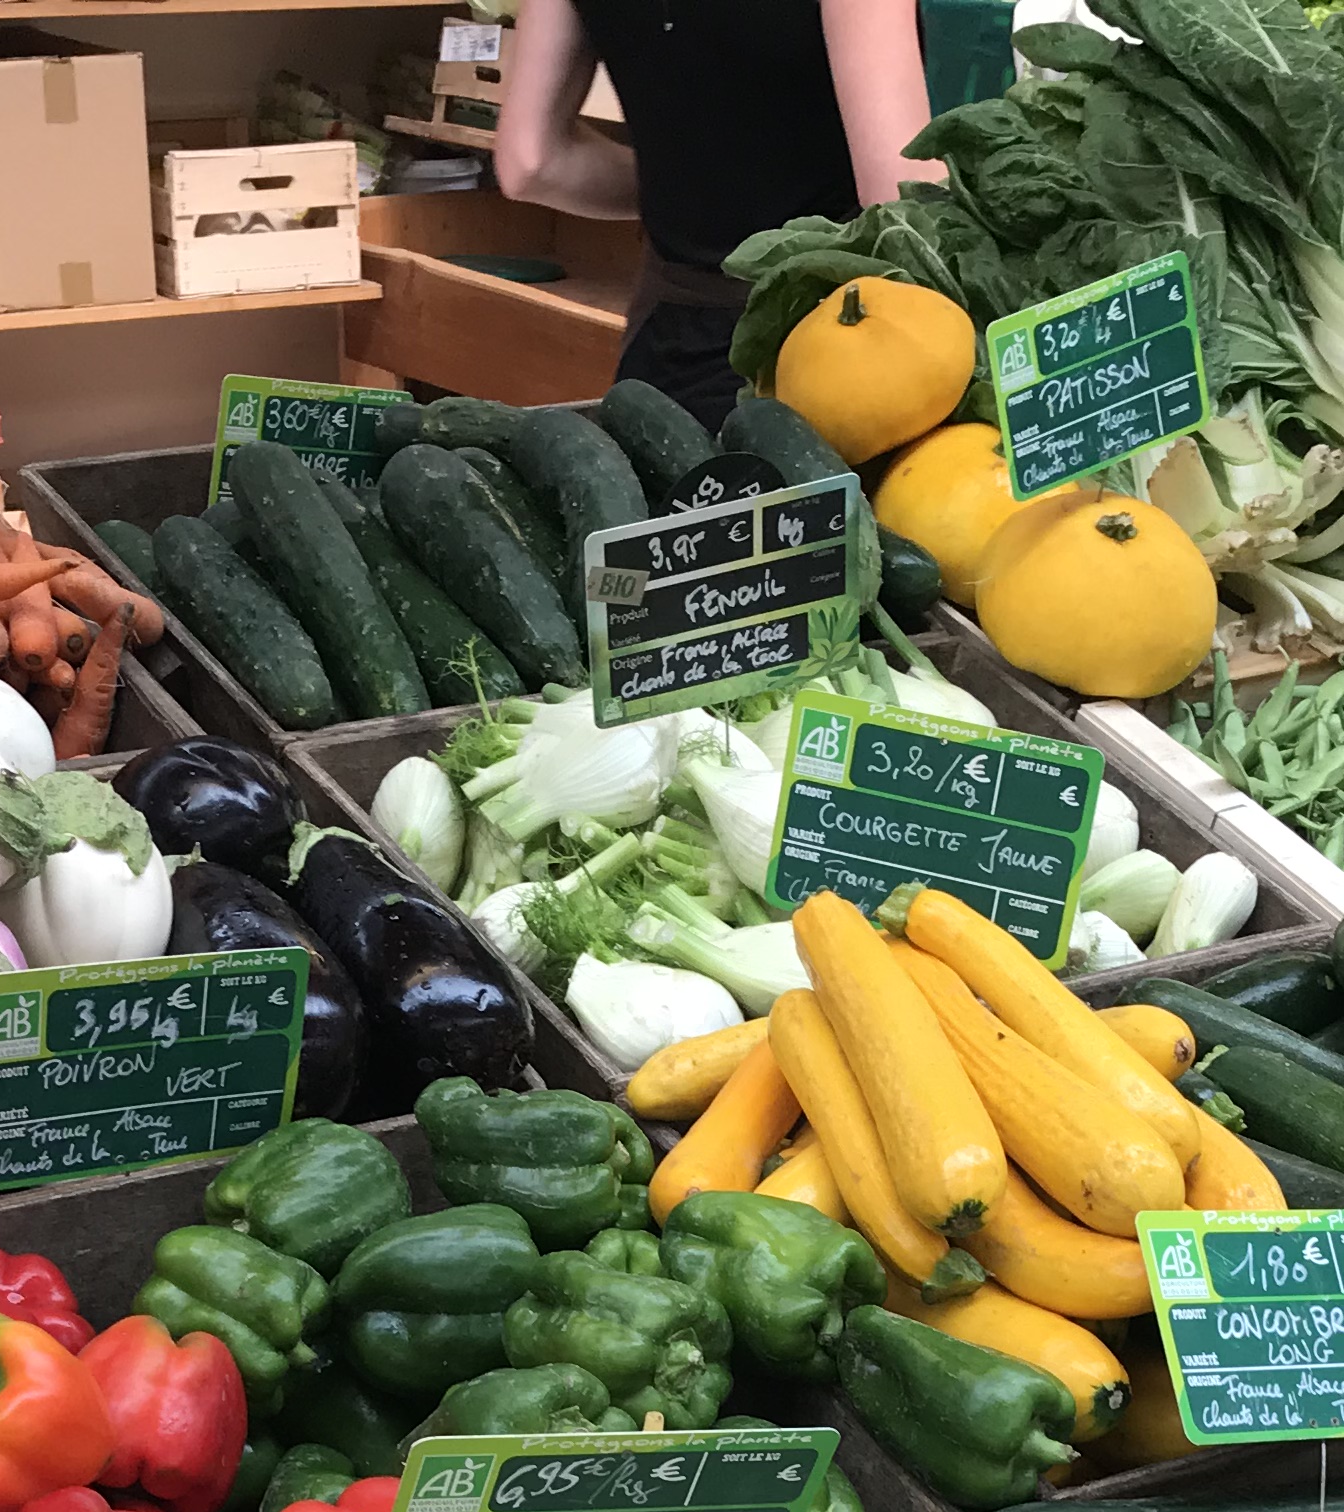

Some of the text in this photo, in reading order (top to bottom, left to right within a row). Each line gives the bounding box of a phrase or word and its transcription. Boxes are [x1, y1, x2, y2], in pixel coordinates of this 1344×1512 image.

[728, 521, 751, 542] €
[829, 514, 845, 531] €
[599, 572, 637, 598] BIO
[685, 568, 786, 623] FENOUIL
[610, 608, 649, 625] Produit
[613, 653, 653, 671] Origine
[800, 726, 840, 760] AB
[868, 704, 1085, 762] Protégeons la planète
[963, 754, 991, 784] €
[794, 784, 832, 801] PRODUIT
[1059, 785, 1080, 807] €
[788, 826, 826, 845] VARIÉTÉ
[818, 802, 1062, 877] COURGETTE JAUNE
[784, 848, 820, 863] ORIGINE
[58, 954, 288, 984] Protégeons la planète
[268, 986, 289, 1006] €
[69, 996, 154, 1049] 3,95
[166, 983, 197, 1010] €
[165, 1062, 243, 1098] VERT
[62, 1145, 84, 1165] de
[1203, 1211, 1302, 1232] Protégeons
[1308, 1211, 1322, 1224] la
[1161, 1245, 1196, 1278] AB
[1229, 1236, 1329, 1292] 1,80 €
[1172, 1308, 1207, 1321] PRODUIT
[1268, 1339, 1335, 1366] LONG
[1187, 1375, 1223, 1387] ORIGINE
[1259, 1404, 1279, 1426] de
[521, 1433, 814, 1454] Protégeons la planète
[650, 1456, 688, 1482] €
[722, 1453, 744, 1463] SOIT
[418, 1469, 475, 1499] AB
[776, 1464, 802, 1483] €
